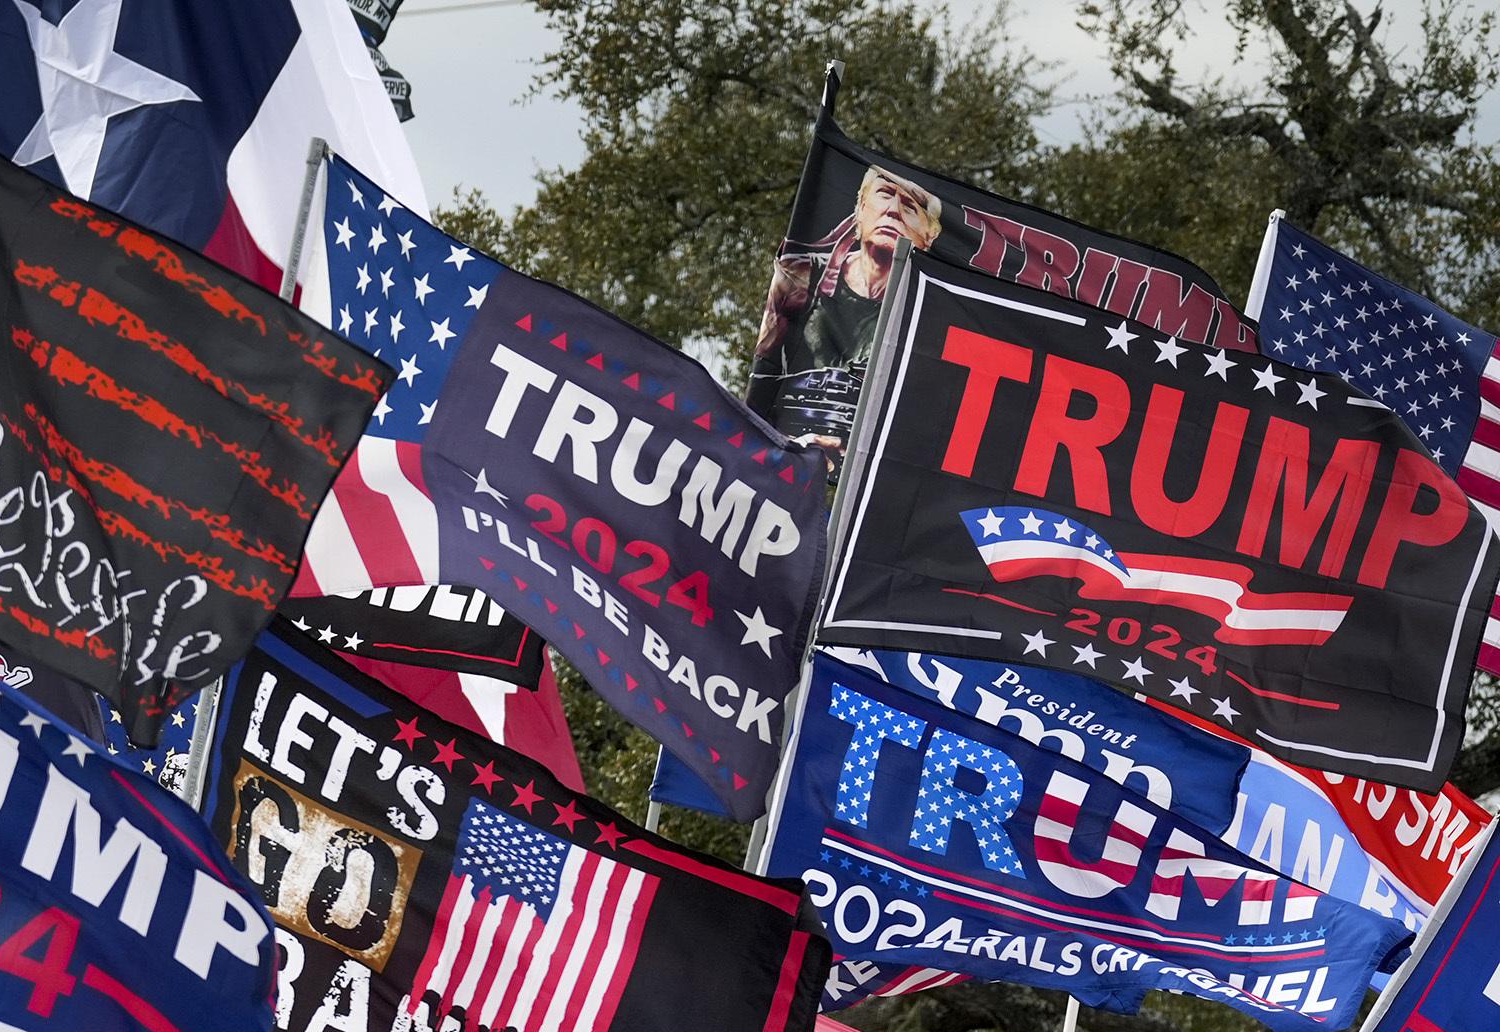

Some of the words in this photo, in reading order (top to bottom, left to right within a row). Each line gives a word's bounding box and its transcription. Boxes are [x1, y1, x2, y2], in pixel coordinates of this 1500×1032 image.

[485, 343, 801, 578] TRUMP
[941, 325, 1471, 590] TRUMP
[523, 493, 715, 628] 2024
[1063, 609, 1218, 676] 2024
[570, 564, 629, 637] BE
[641, 624, 780, 745] BACK
[990, 668, 1139, 750] President
[242, 671, 446, 841] LET'S
[236, 776, 400, 955] GO
[1090, 942, 1164, 976] CRY
